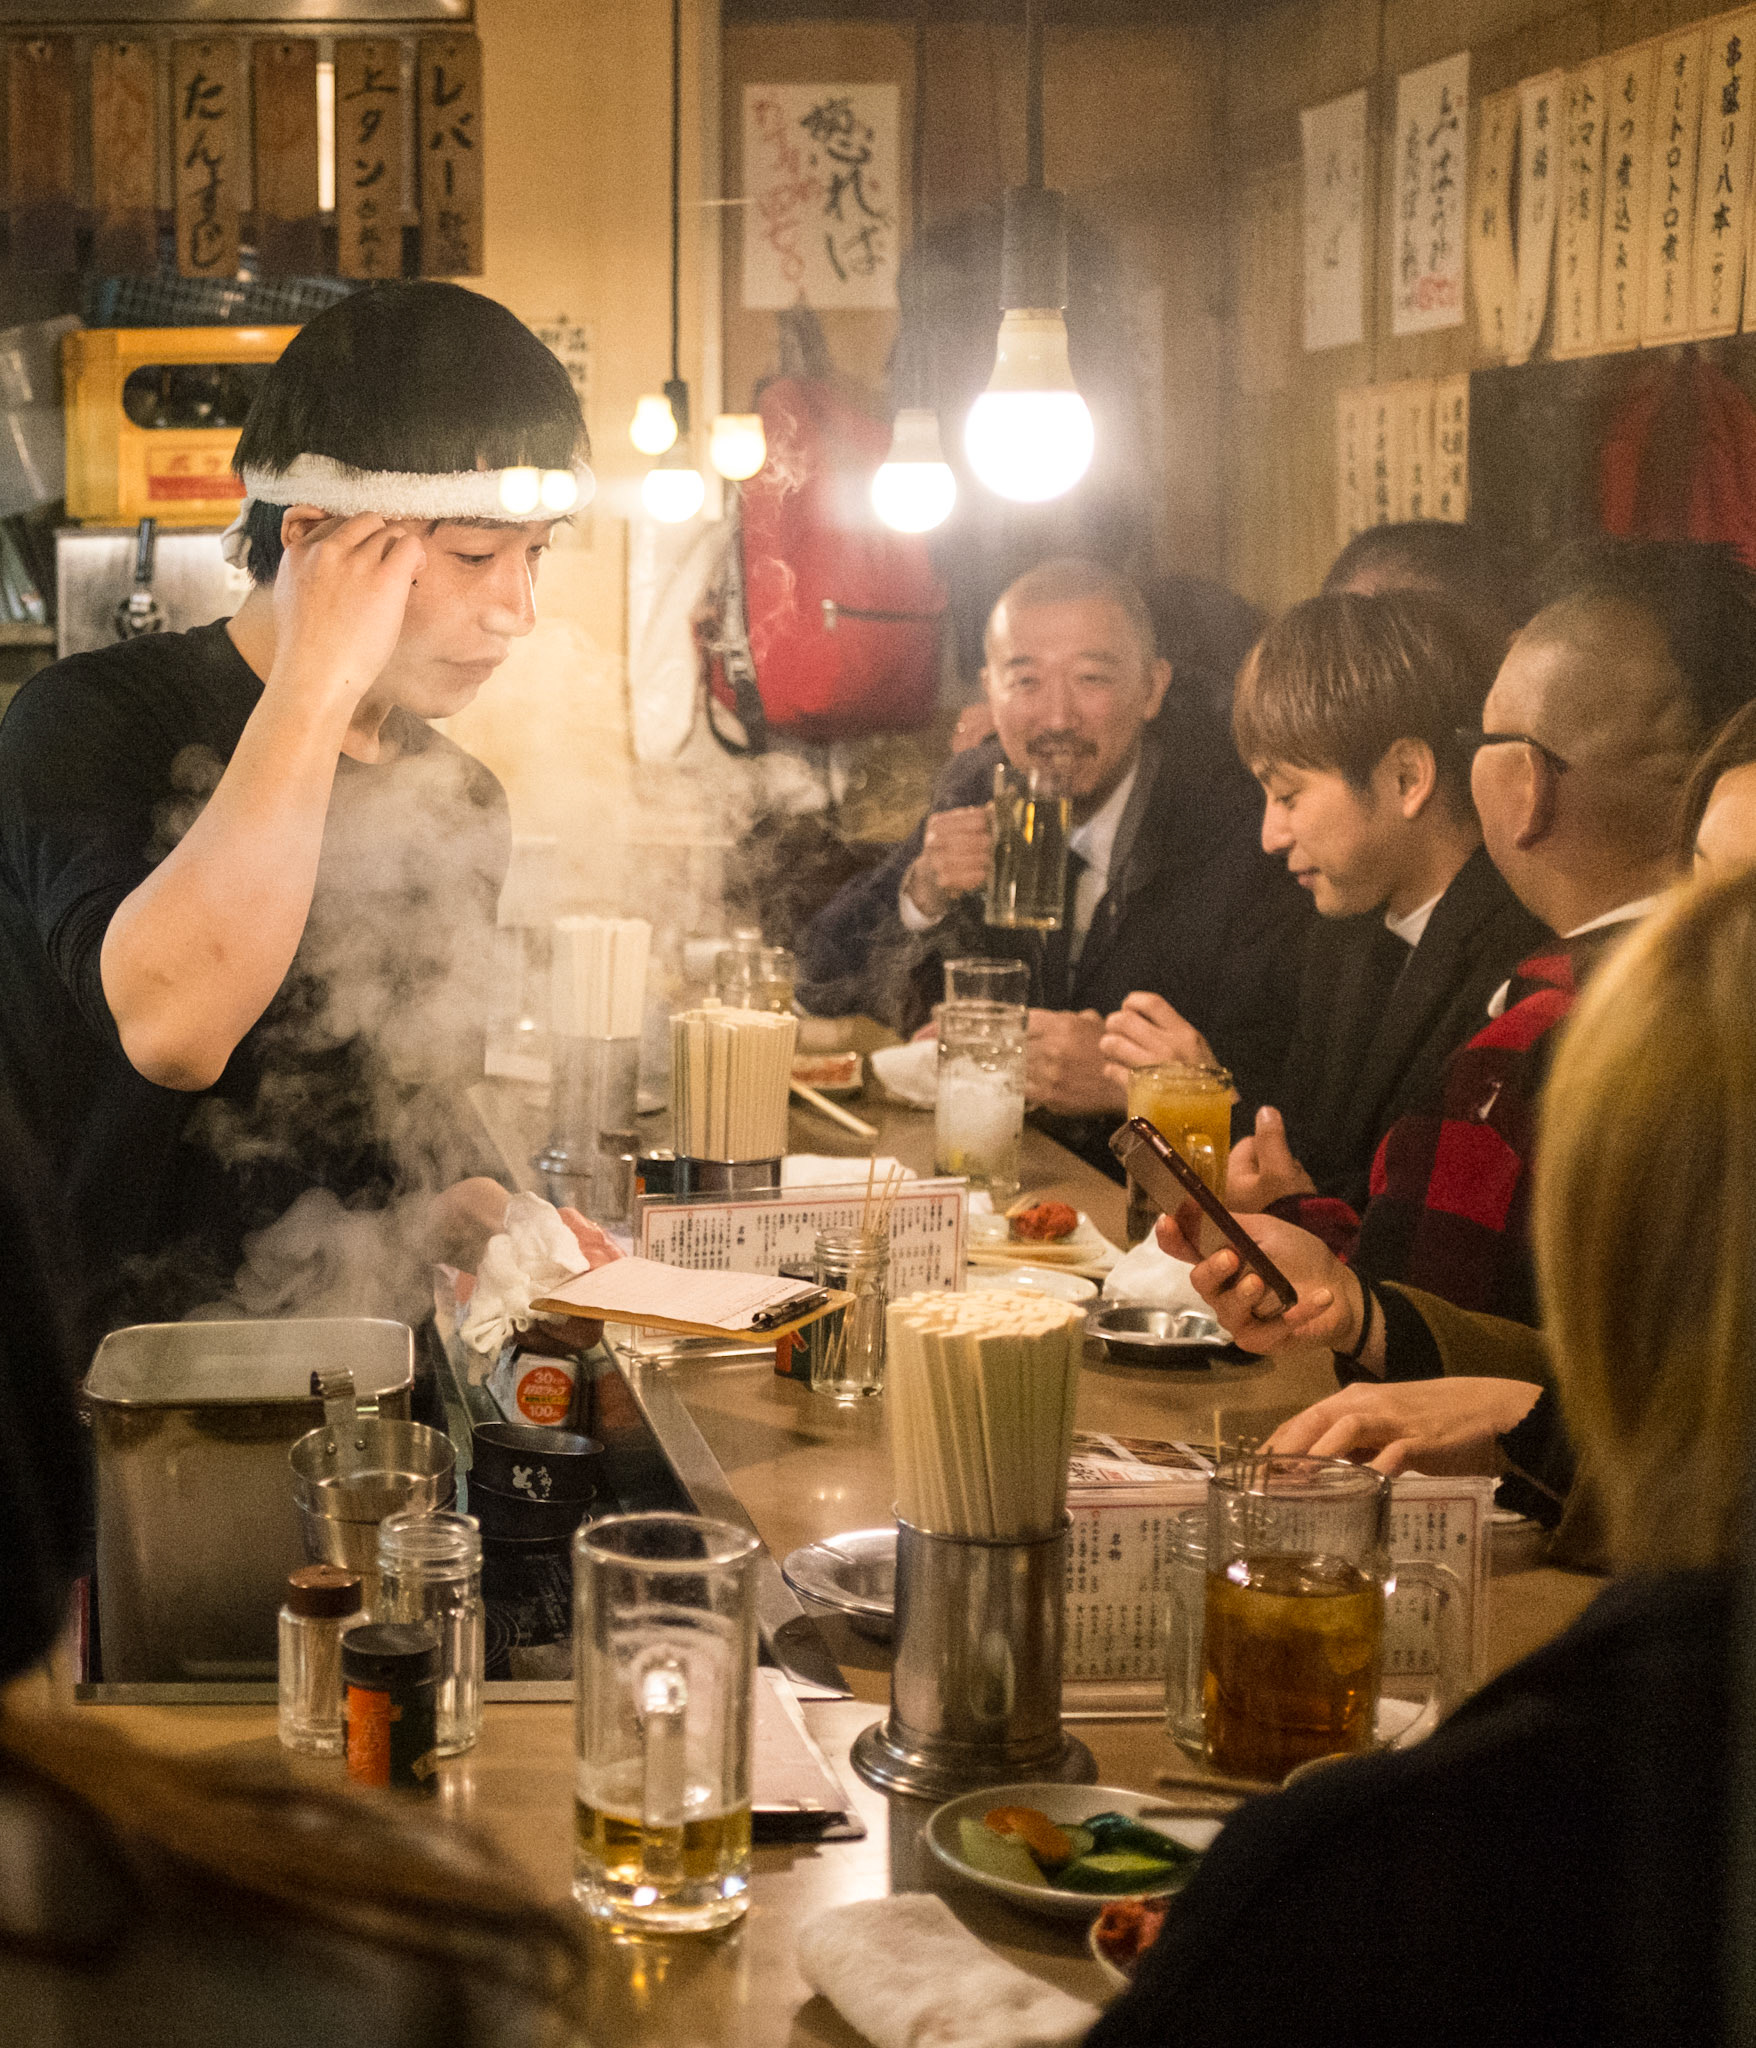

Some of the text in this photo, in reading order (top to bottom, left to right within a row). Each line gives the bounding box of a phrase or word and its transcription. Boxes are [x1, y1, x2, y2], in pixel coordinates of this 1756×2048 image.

[1710, 34, 1743, 239] 串盛り八本
